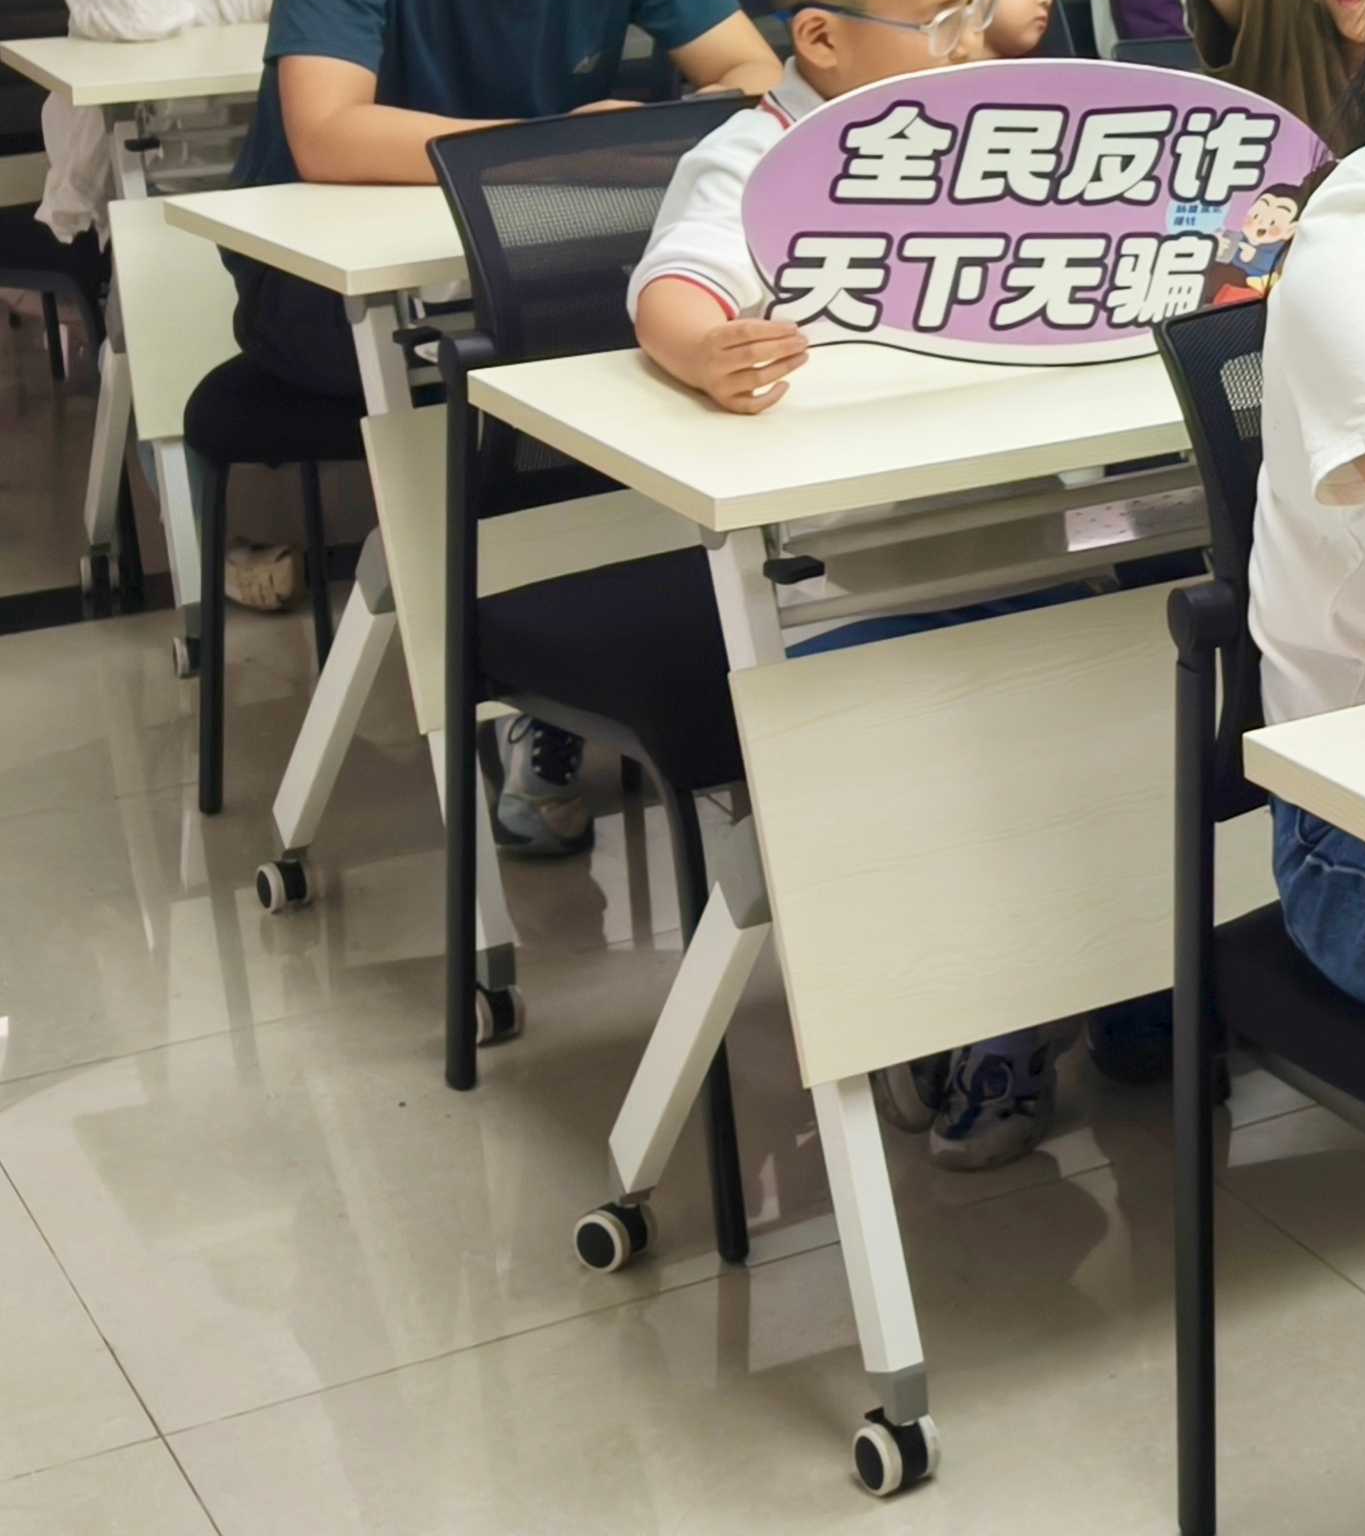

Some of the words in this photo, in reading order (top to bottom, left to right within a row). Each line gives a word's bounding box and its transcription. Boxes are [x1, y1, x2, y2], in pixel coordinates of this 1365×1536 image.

[830, 102, 1281, 206] 全民反诈
[768, 231, 1219, 332] 天下无骗
